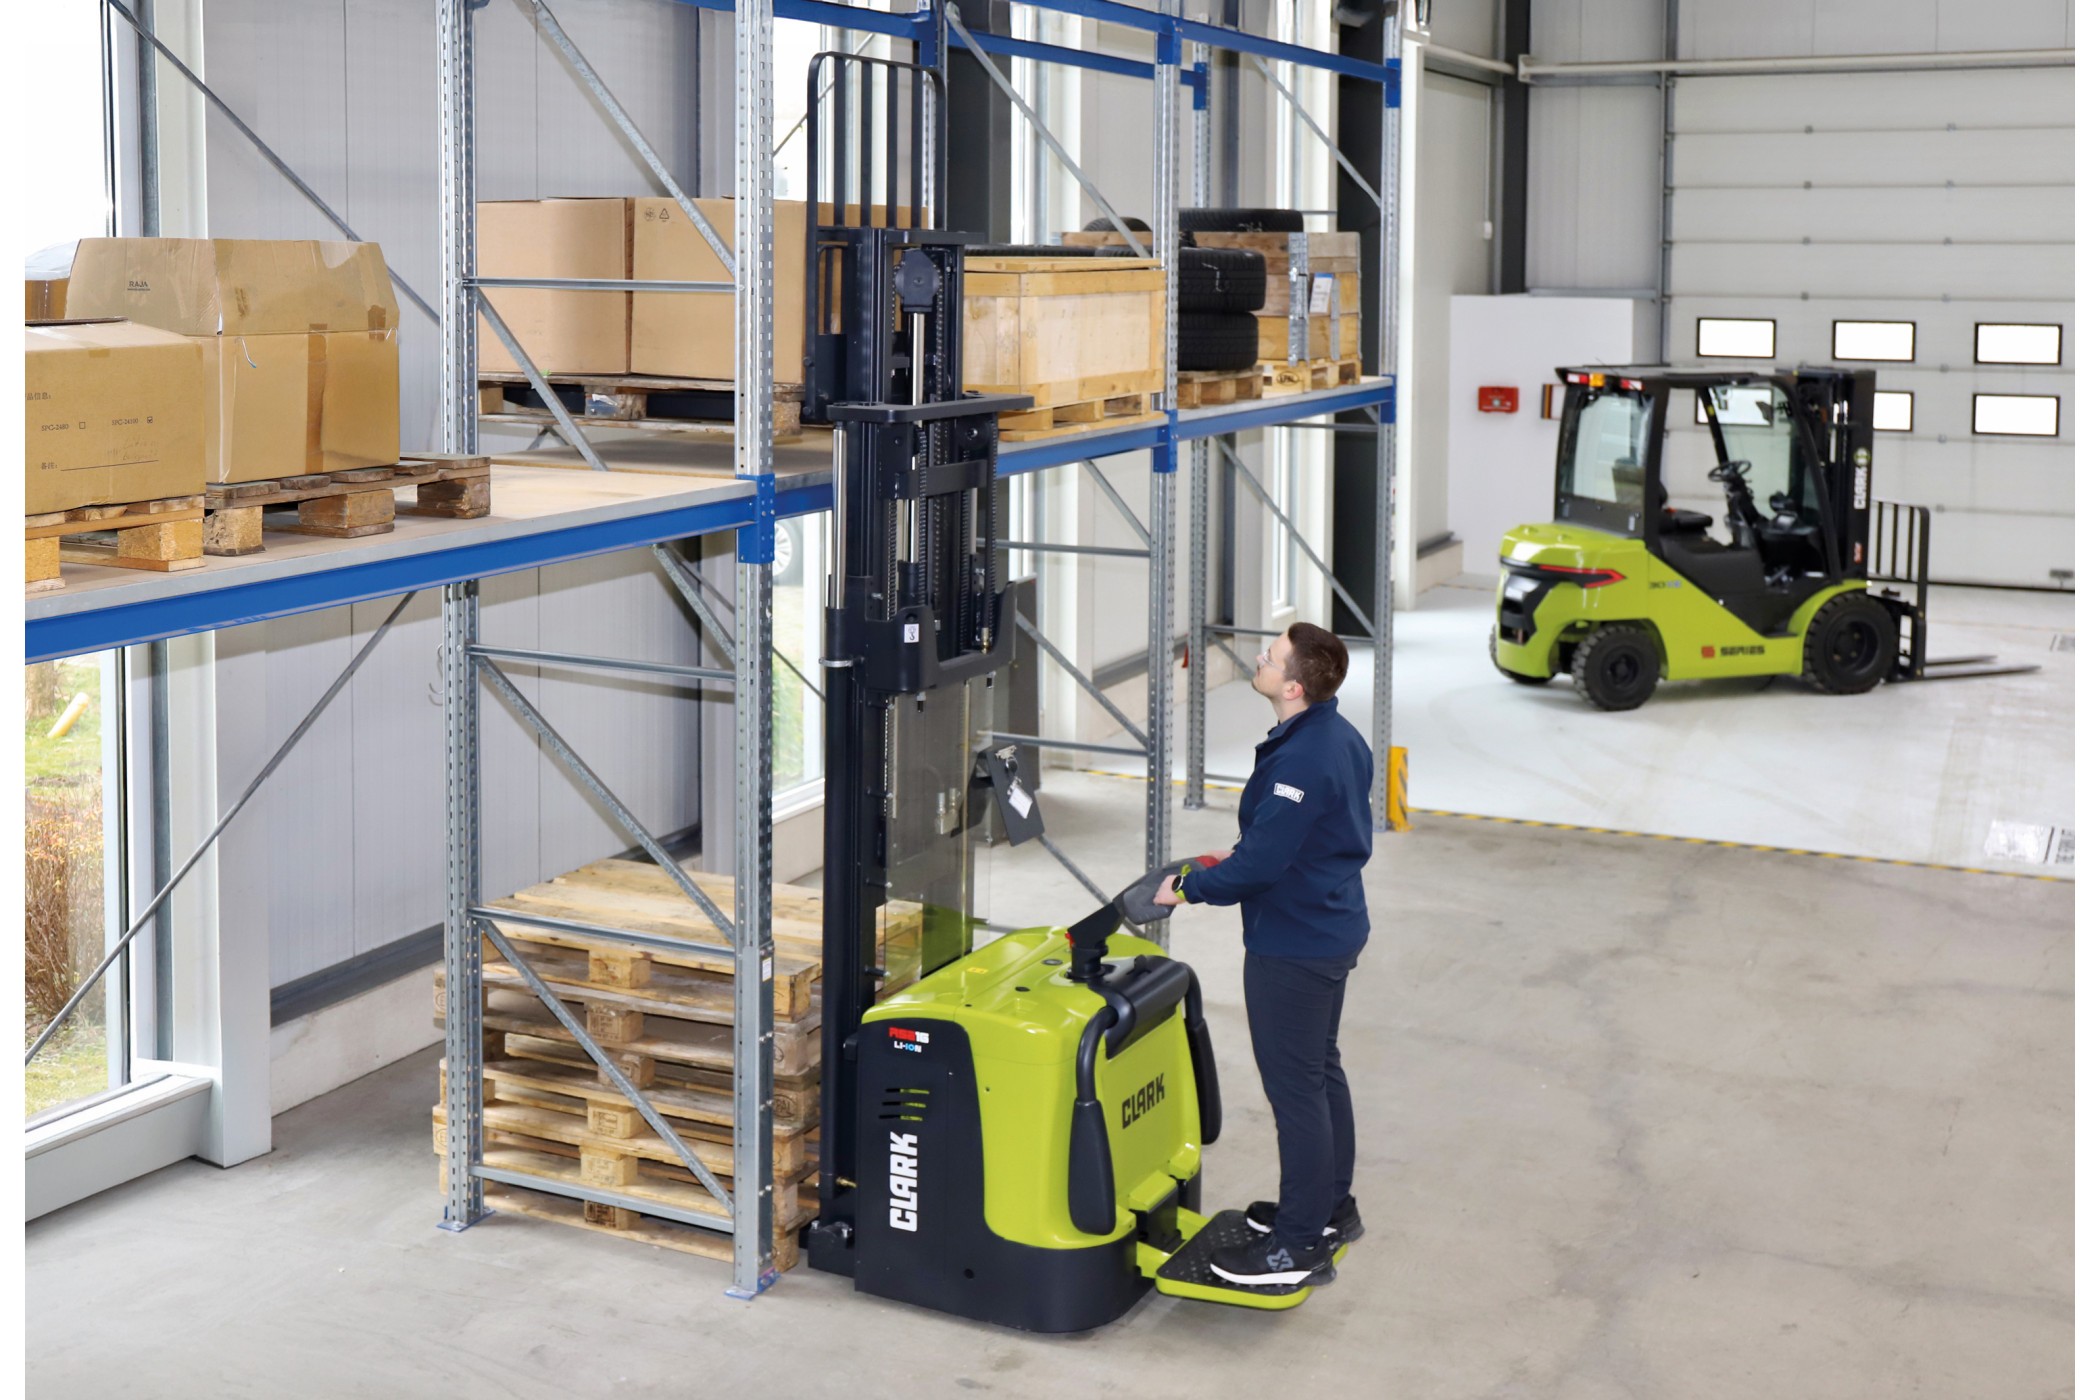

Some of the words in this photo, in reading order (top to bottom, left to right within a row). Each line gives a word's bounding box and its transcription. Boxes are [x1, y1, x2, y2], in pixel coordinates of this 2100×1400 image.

[1854, 466, 1867, 509] CLARK
[1720, 645, 1765, 656] SERIES
[894, 1041, 922, 1053] LI-ION
[1122, 1072, 1165, 1130] CLARK
[890, 1131, 918, 1232] CLARK
